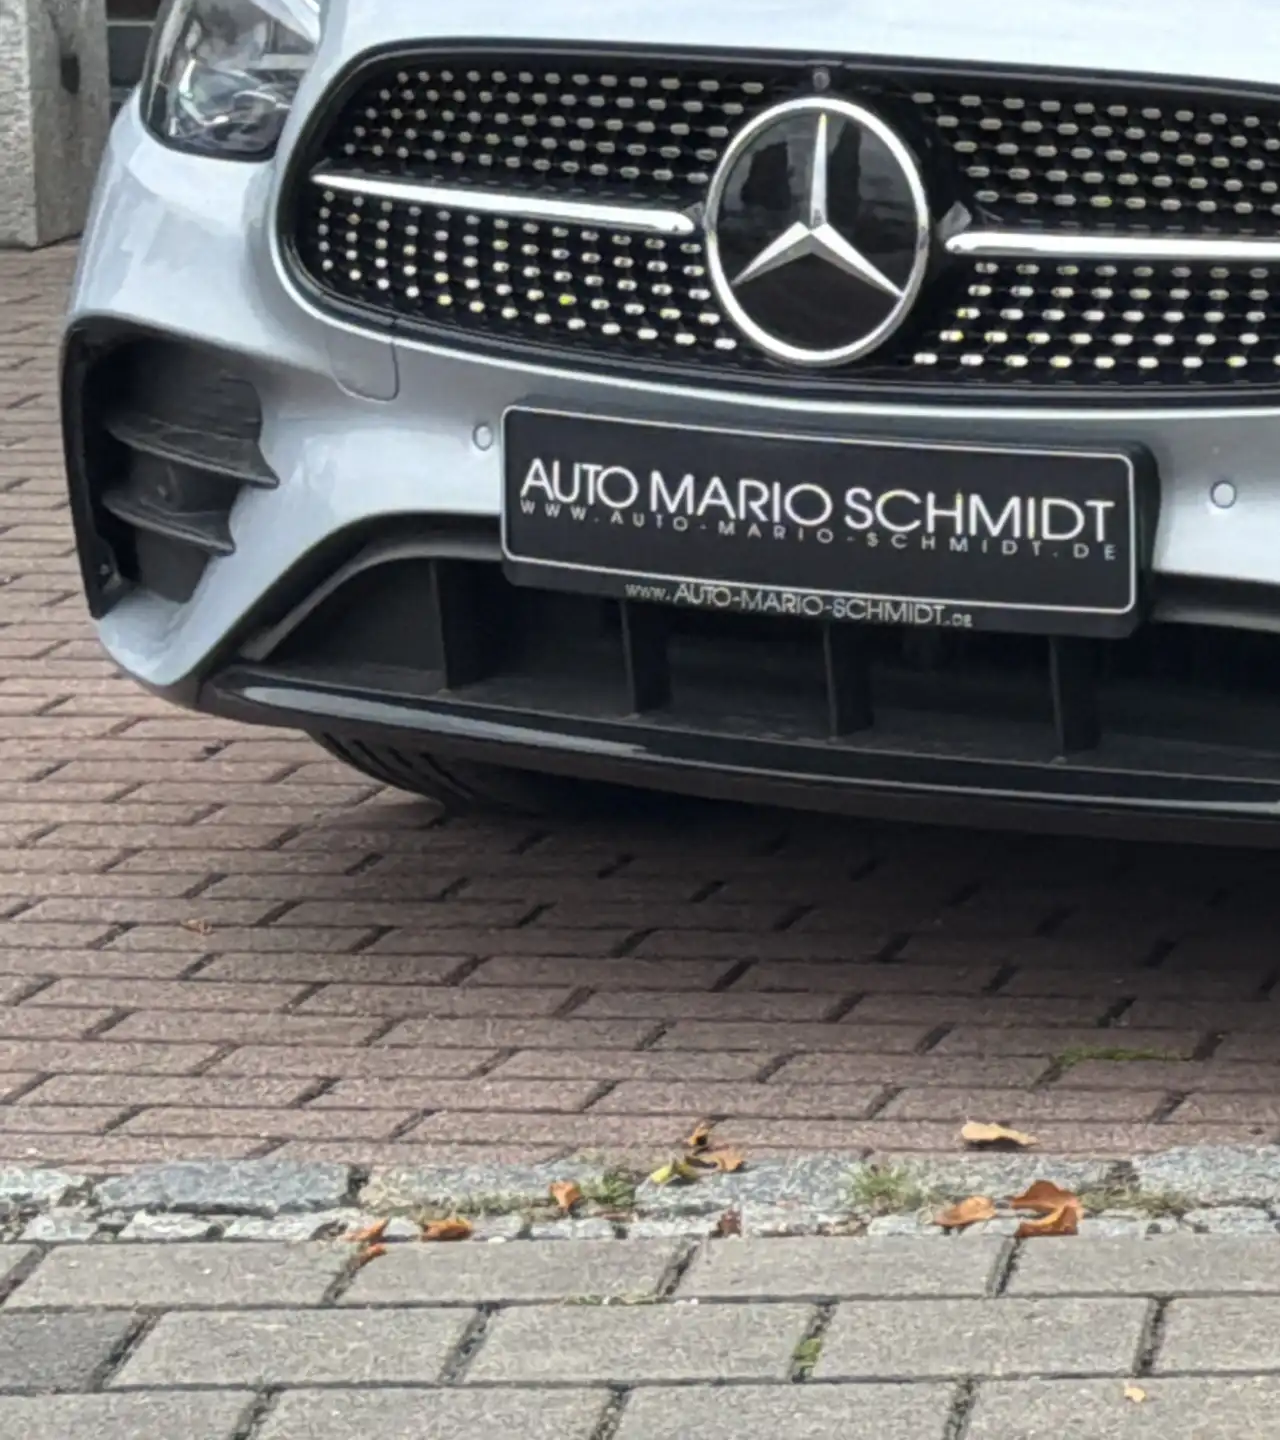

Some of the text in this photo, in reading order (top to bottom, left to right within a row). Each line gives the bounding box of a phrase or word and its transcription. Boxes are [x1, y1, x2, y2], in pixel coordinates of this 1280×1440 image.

[520, 458, 1116, 543] AUTO MARIO SCHMIDT
